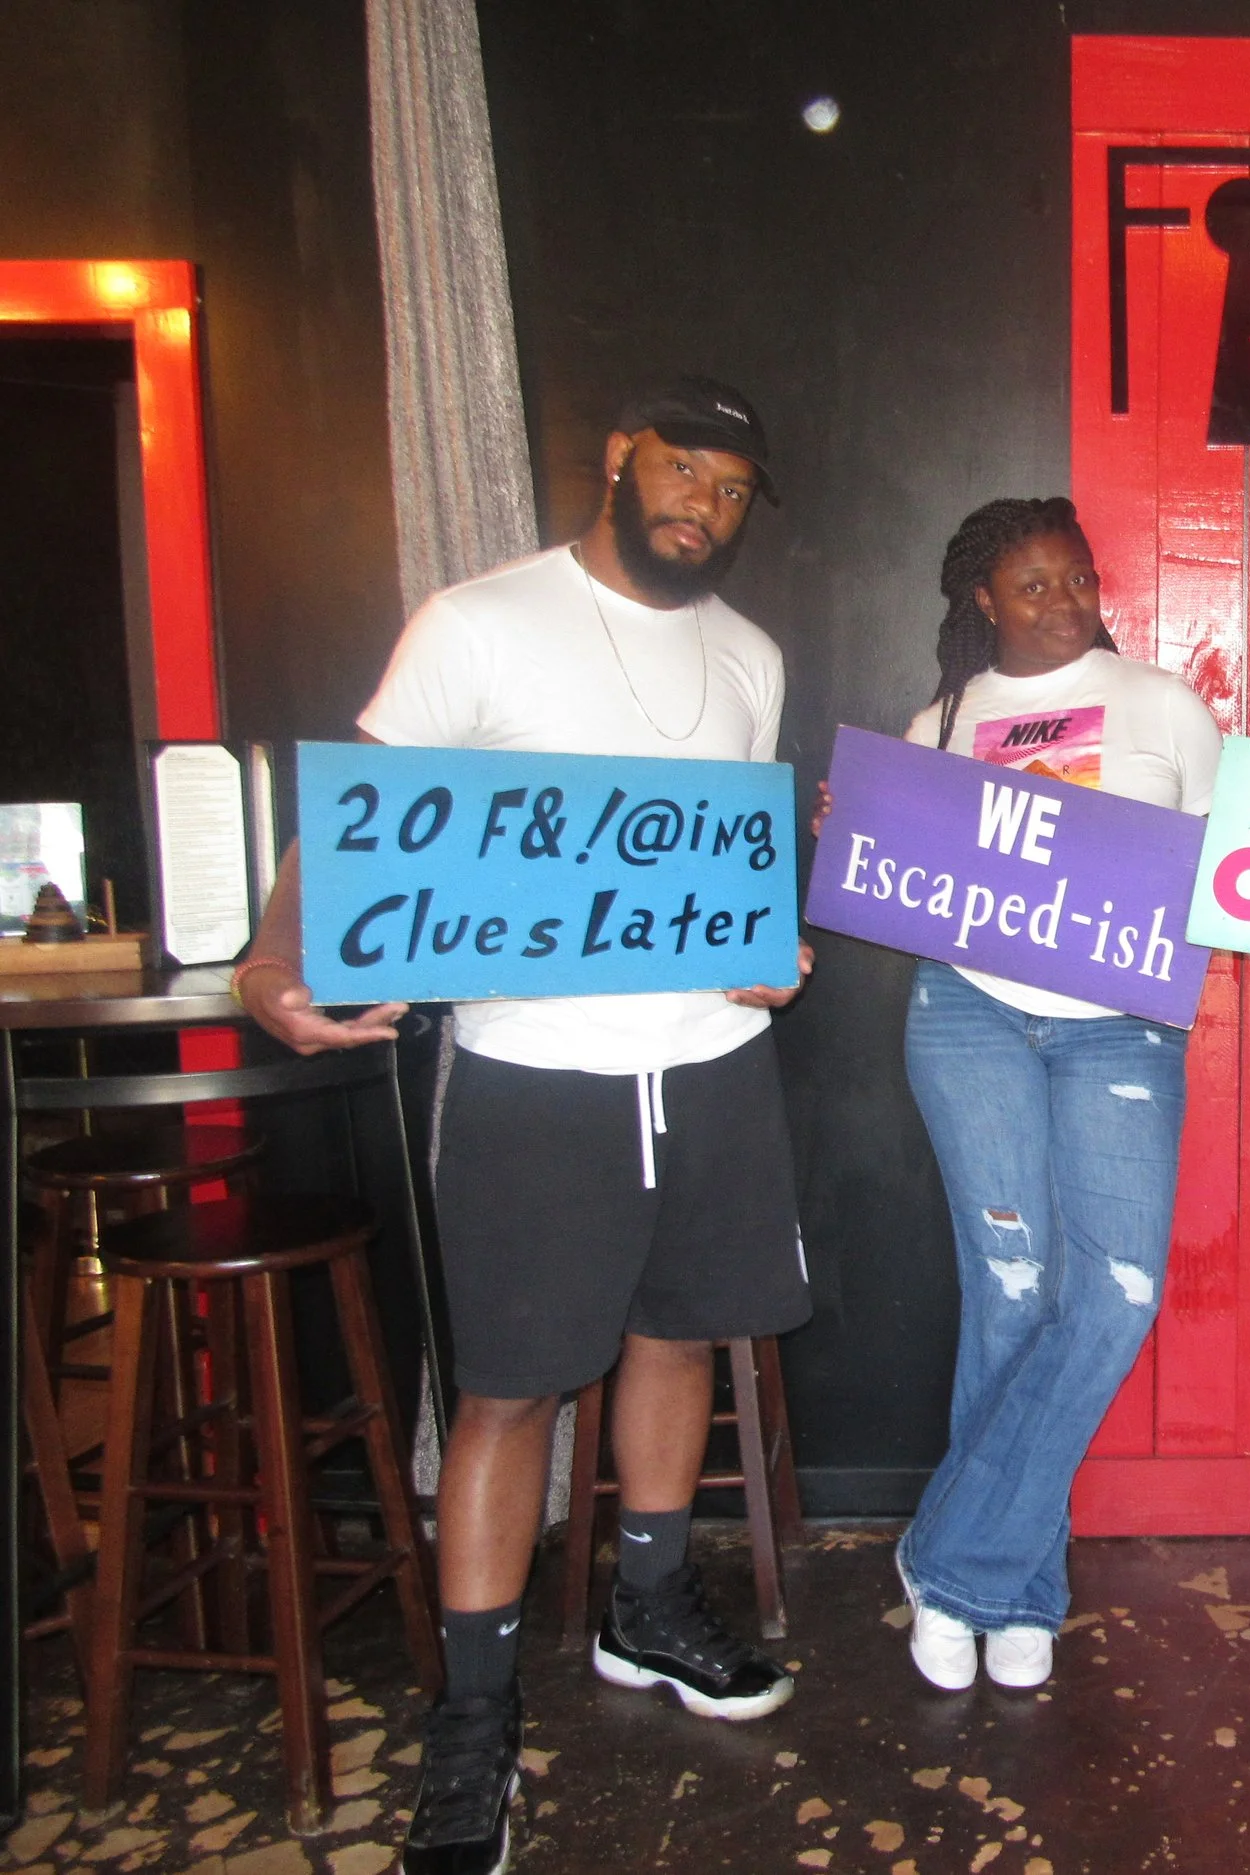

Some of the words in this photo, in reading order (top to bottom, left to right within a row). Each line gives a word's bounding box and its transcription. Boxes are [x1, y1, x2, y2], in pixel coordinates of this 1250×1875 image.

[1001, 717, 1073, 749] NIKE
[336, 782, 454, 854] 20
[977, 780, 1063, 866] WE
[339, 888, 564, 969] Clues
[581, 889, 772, 958] Later
[841, 832, 1175, 982] Escaped-ish
